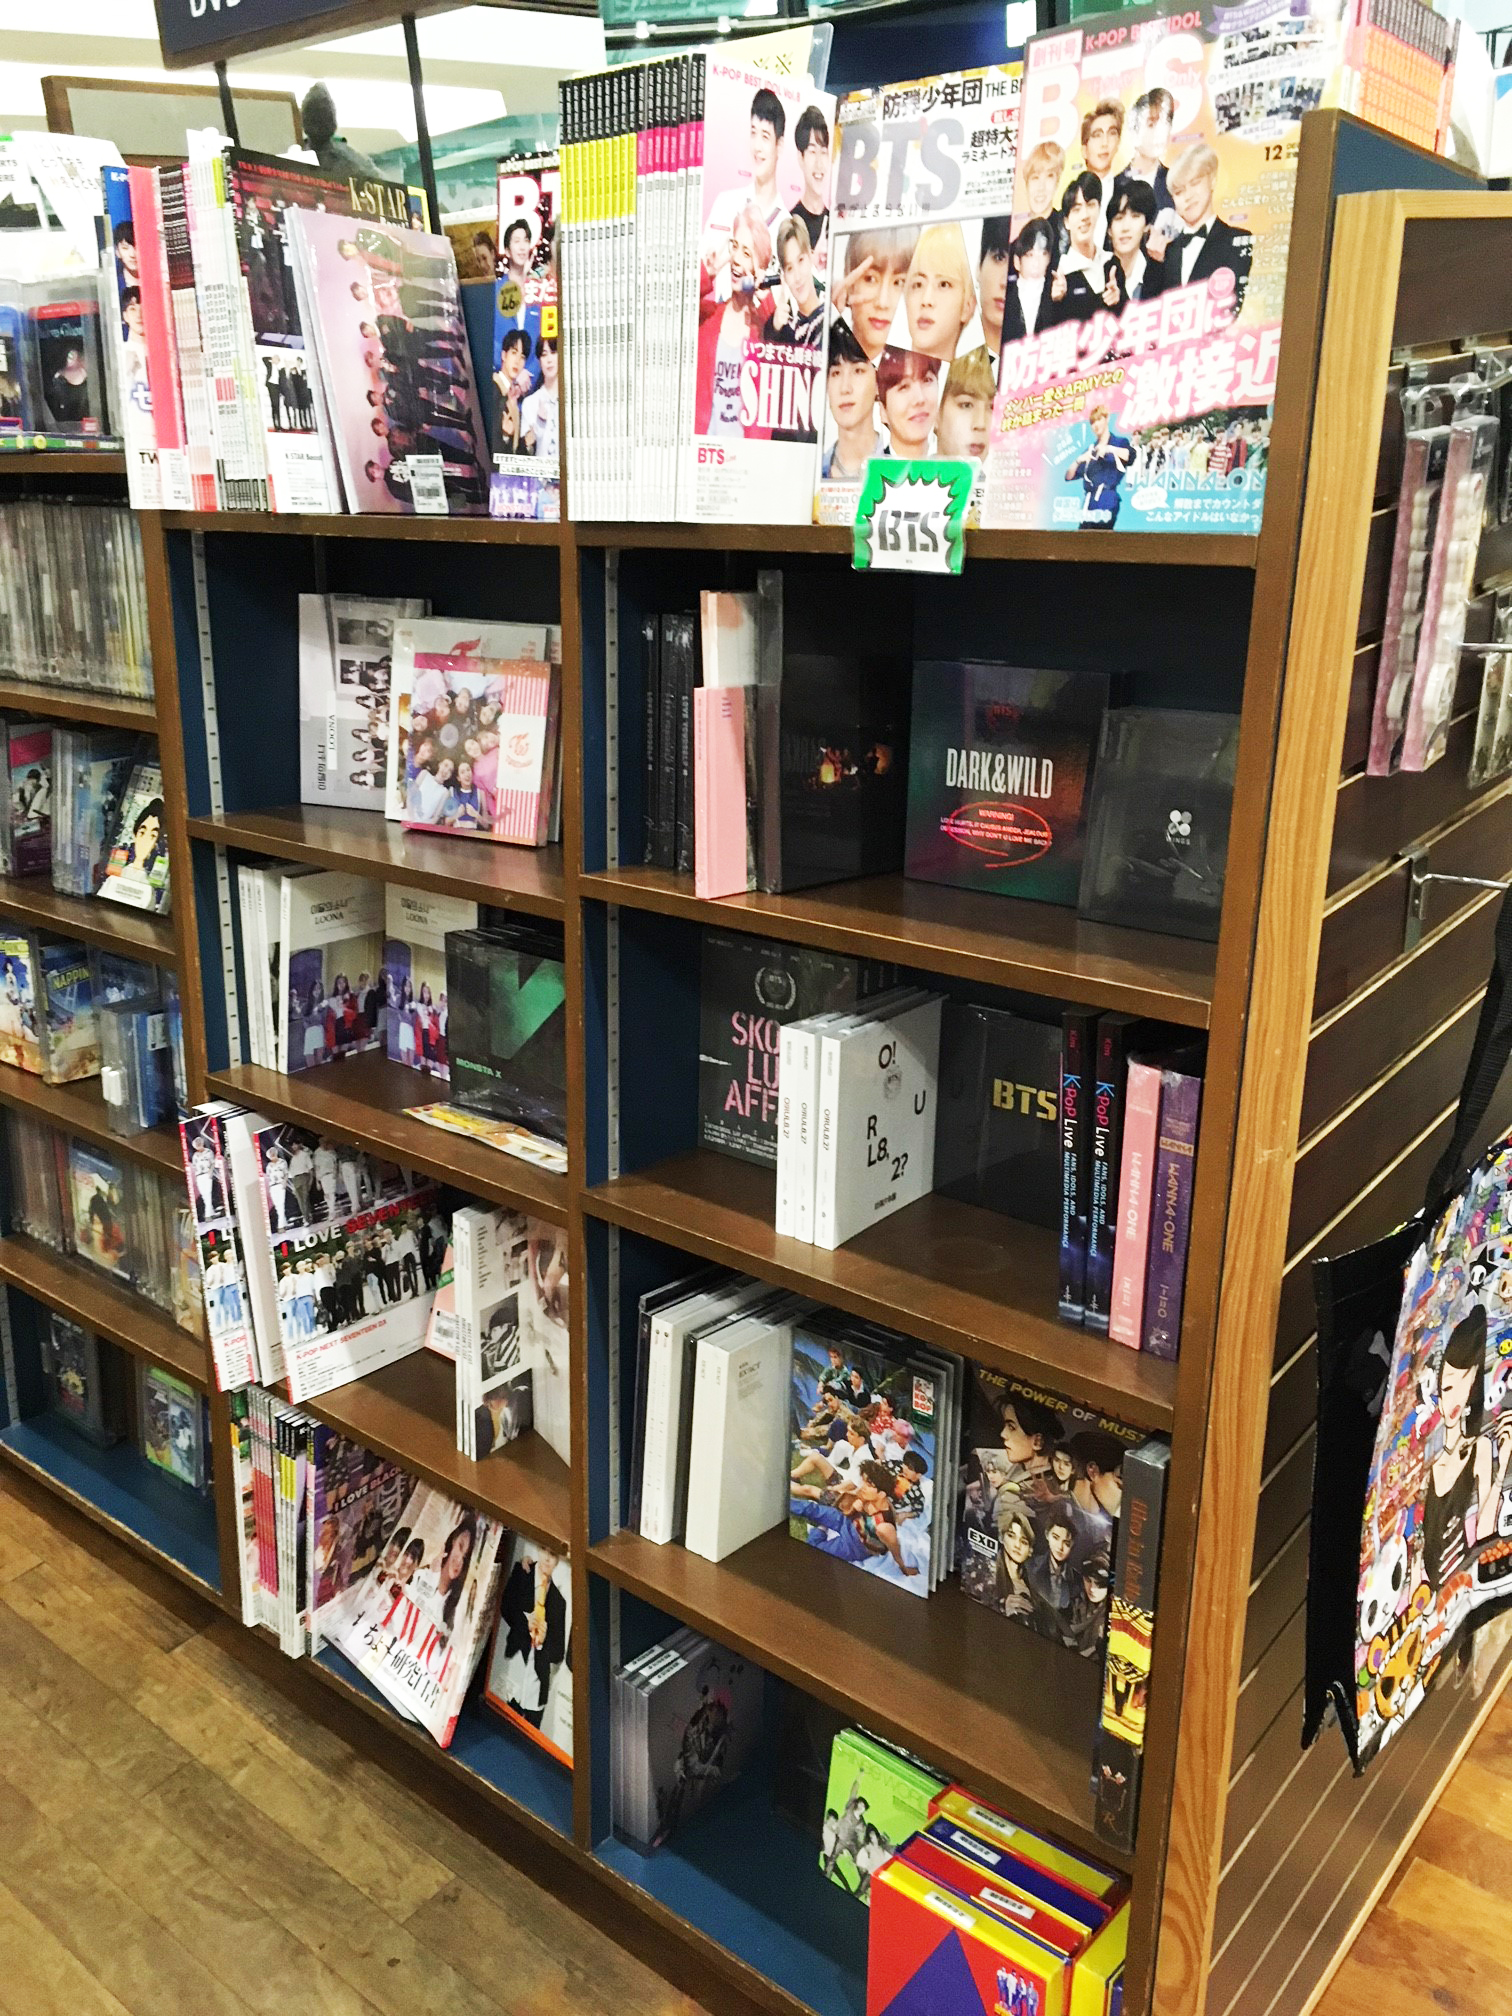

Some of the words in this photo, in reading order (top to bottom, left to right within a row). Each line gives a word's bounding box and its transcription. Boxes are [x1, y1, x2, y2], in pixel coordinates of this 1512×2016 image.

[1085, 27, 1128, 50] K-POP
[1167, 10, 1203, 34] IDOL
[712, 64, 741, 81] K-POP
[744, 73, 761, 87] BEST
[985, 82, 1007, 97] THE
[835, 118, 965, 210] BTS
[1264, 144, 1283, 161] 12
[697, 447, 725, 464] BTS
[878, 509, 940, 553] BTS
[945, 747, 1054, 800] DARK&WILD
[724, 1079, 779, 1125] AFF
[914, 1089, 926, 1116] U
[992, 1078, 1057, 1121] BTS
[867, 1114, 878, 1140] R
[280, 1241, 289, 1259] I
[293, 1223, 342, 1253] LOVE
[319, 1338, 338, 1353] NEXT
[979, 1369, 1007, 1388] THE
[1009, 1382, 1069, 1412] POWER
[1072, 1407, 1097, 1424] OF
[341, 1485, 369, 1509] LOVE
[969, 1529, 997, 1551] EXO
